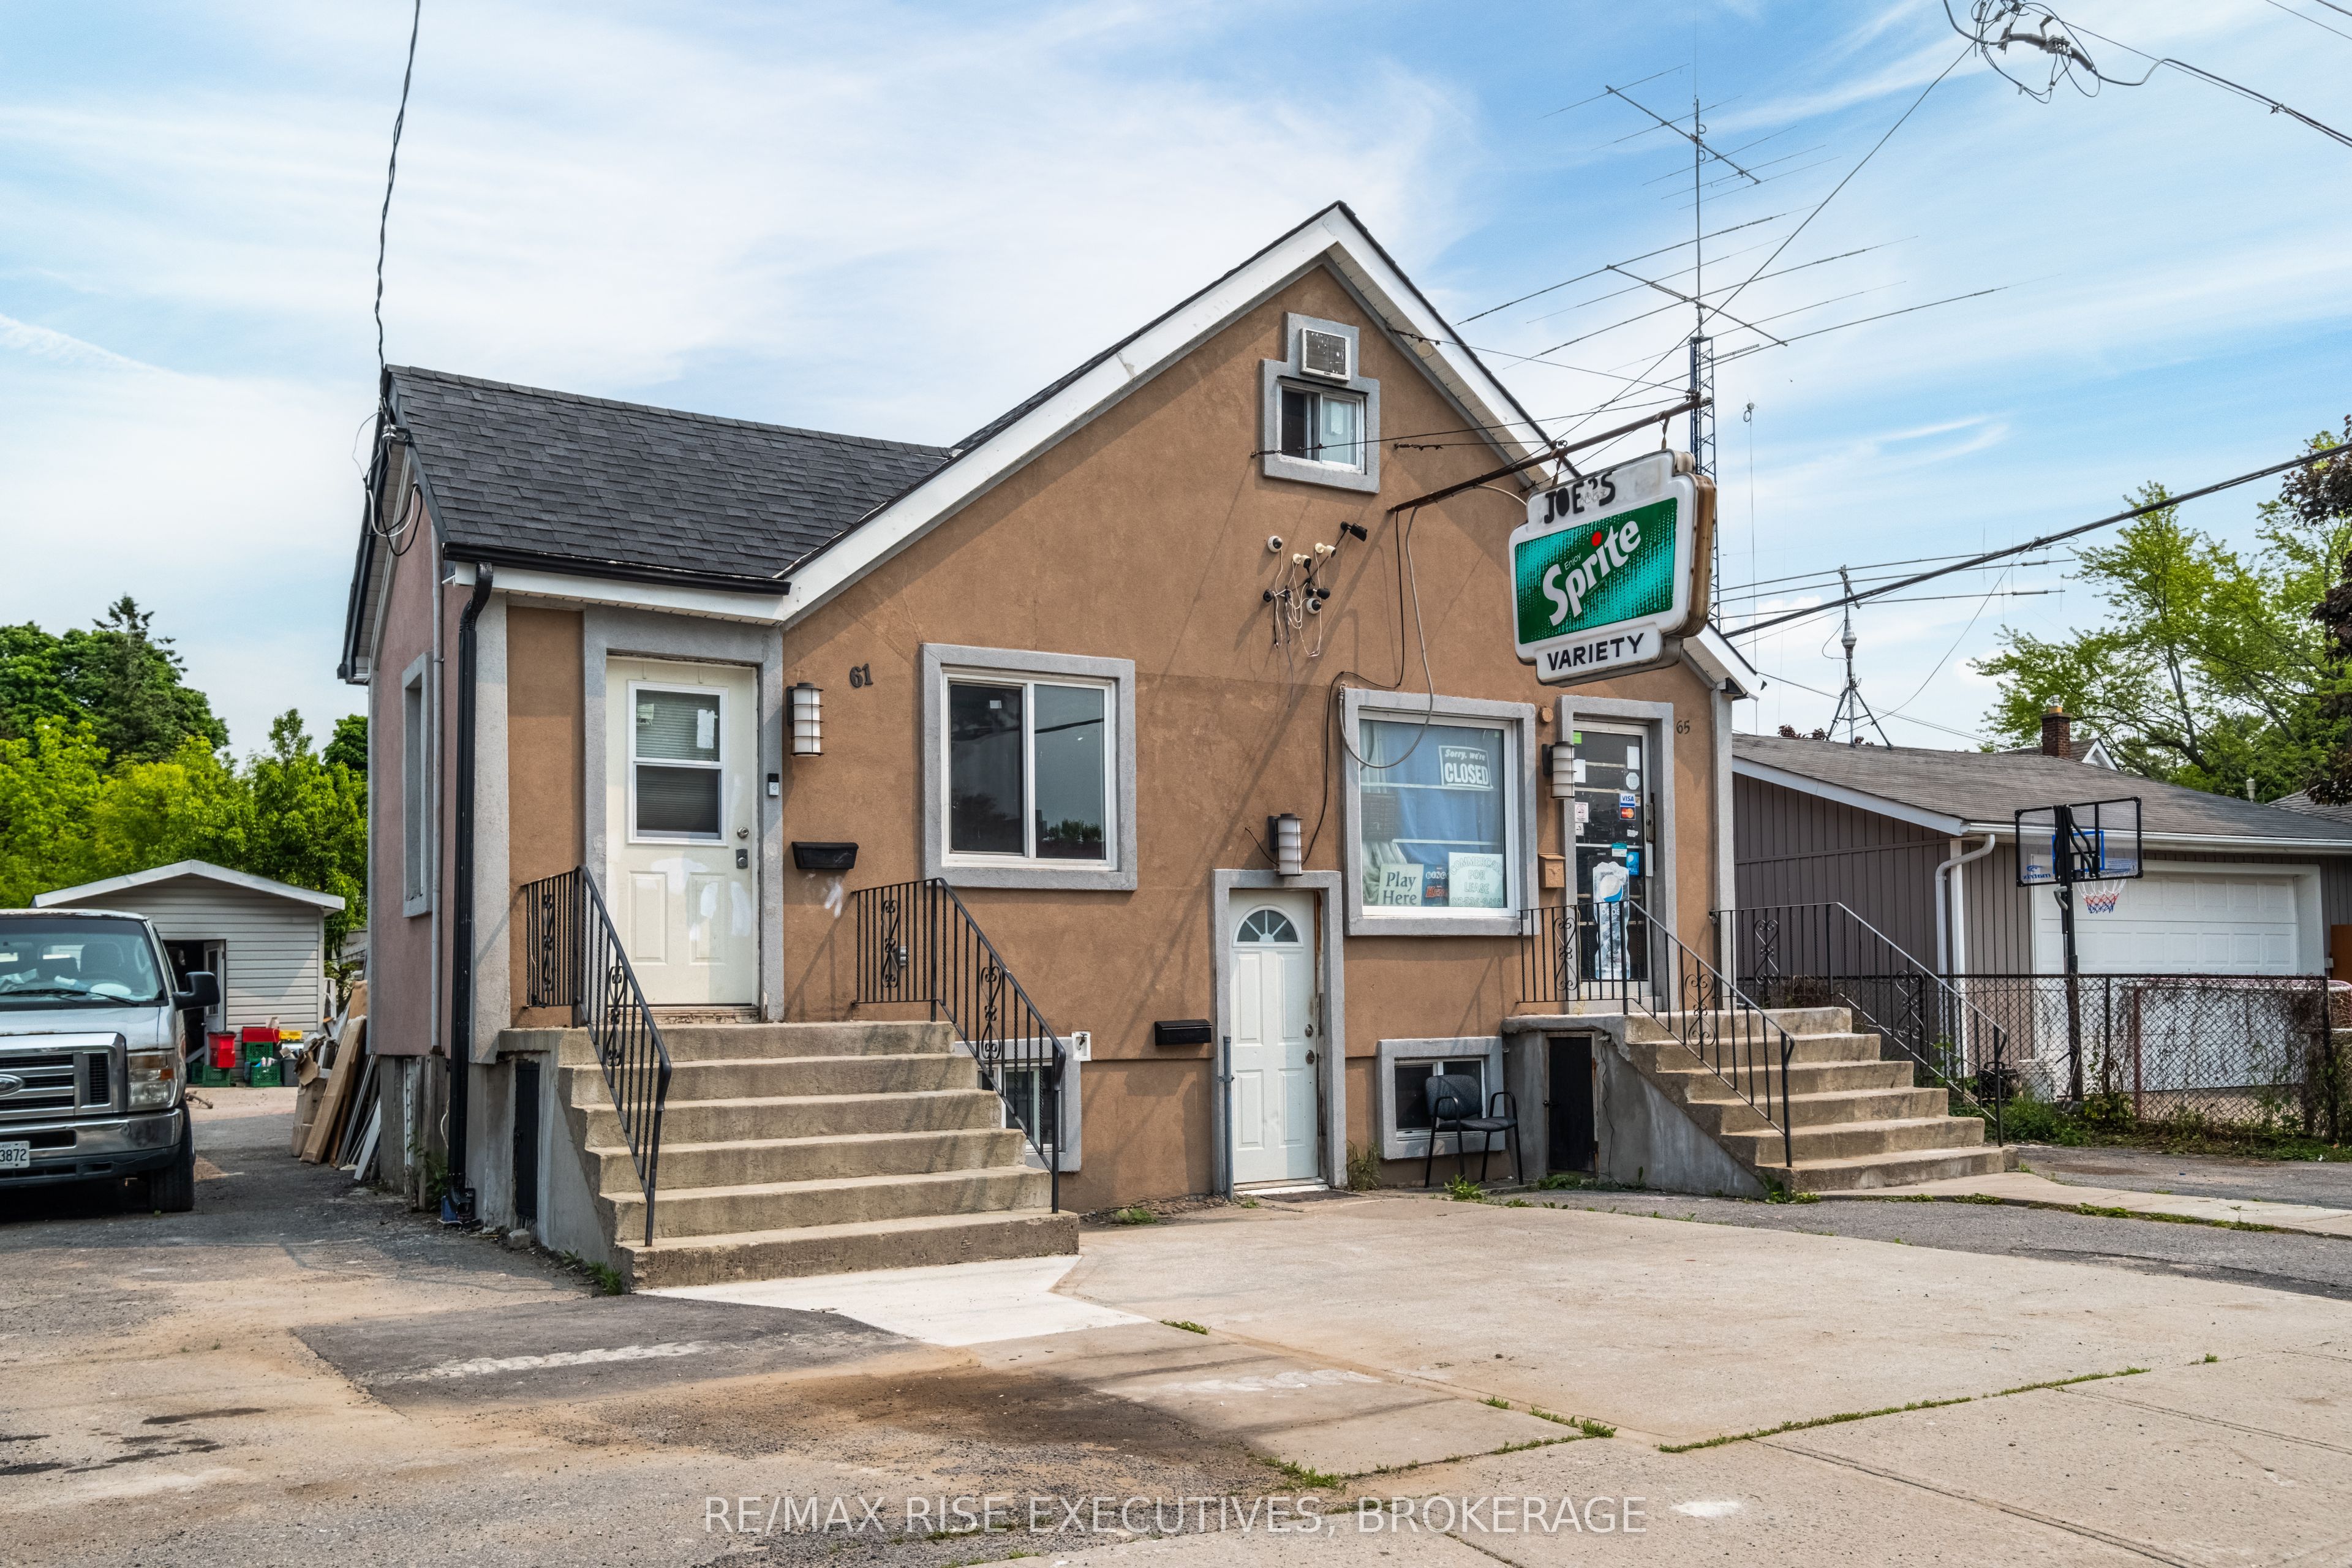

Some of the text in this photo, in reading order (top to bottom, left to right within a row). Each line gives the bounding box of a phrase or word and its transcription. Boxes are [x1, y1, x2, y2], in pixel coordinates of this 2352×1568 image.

[1544, 470, 1616, 524] JOE'S
[1564, 552, 1581, 570] Enjoy
[1542, 521, 1642, 626] Sprite
[1547, 633, 1645, 671] VARIETY
[850, 663, 873, 688] 61
[1676, 720, 1691, 734] 65
[1470, 752, 1485, 761] we're
[1444, 763, 1489, 785] CLOSED
[1386, 871, 1417, 891] Play
[1468, 869, 1486, 880] FOR
[1464, 881, 1490, 894] LEASE
[1383, 890, 1417, 905] Here
[1601, 908, 1619, 917] peps
